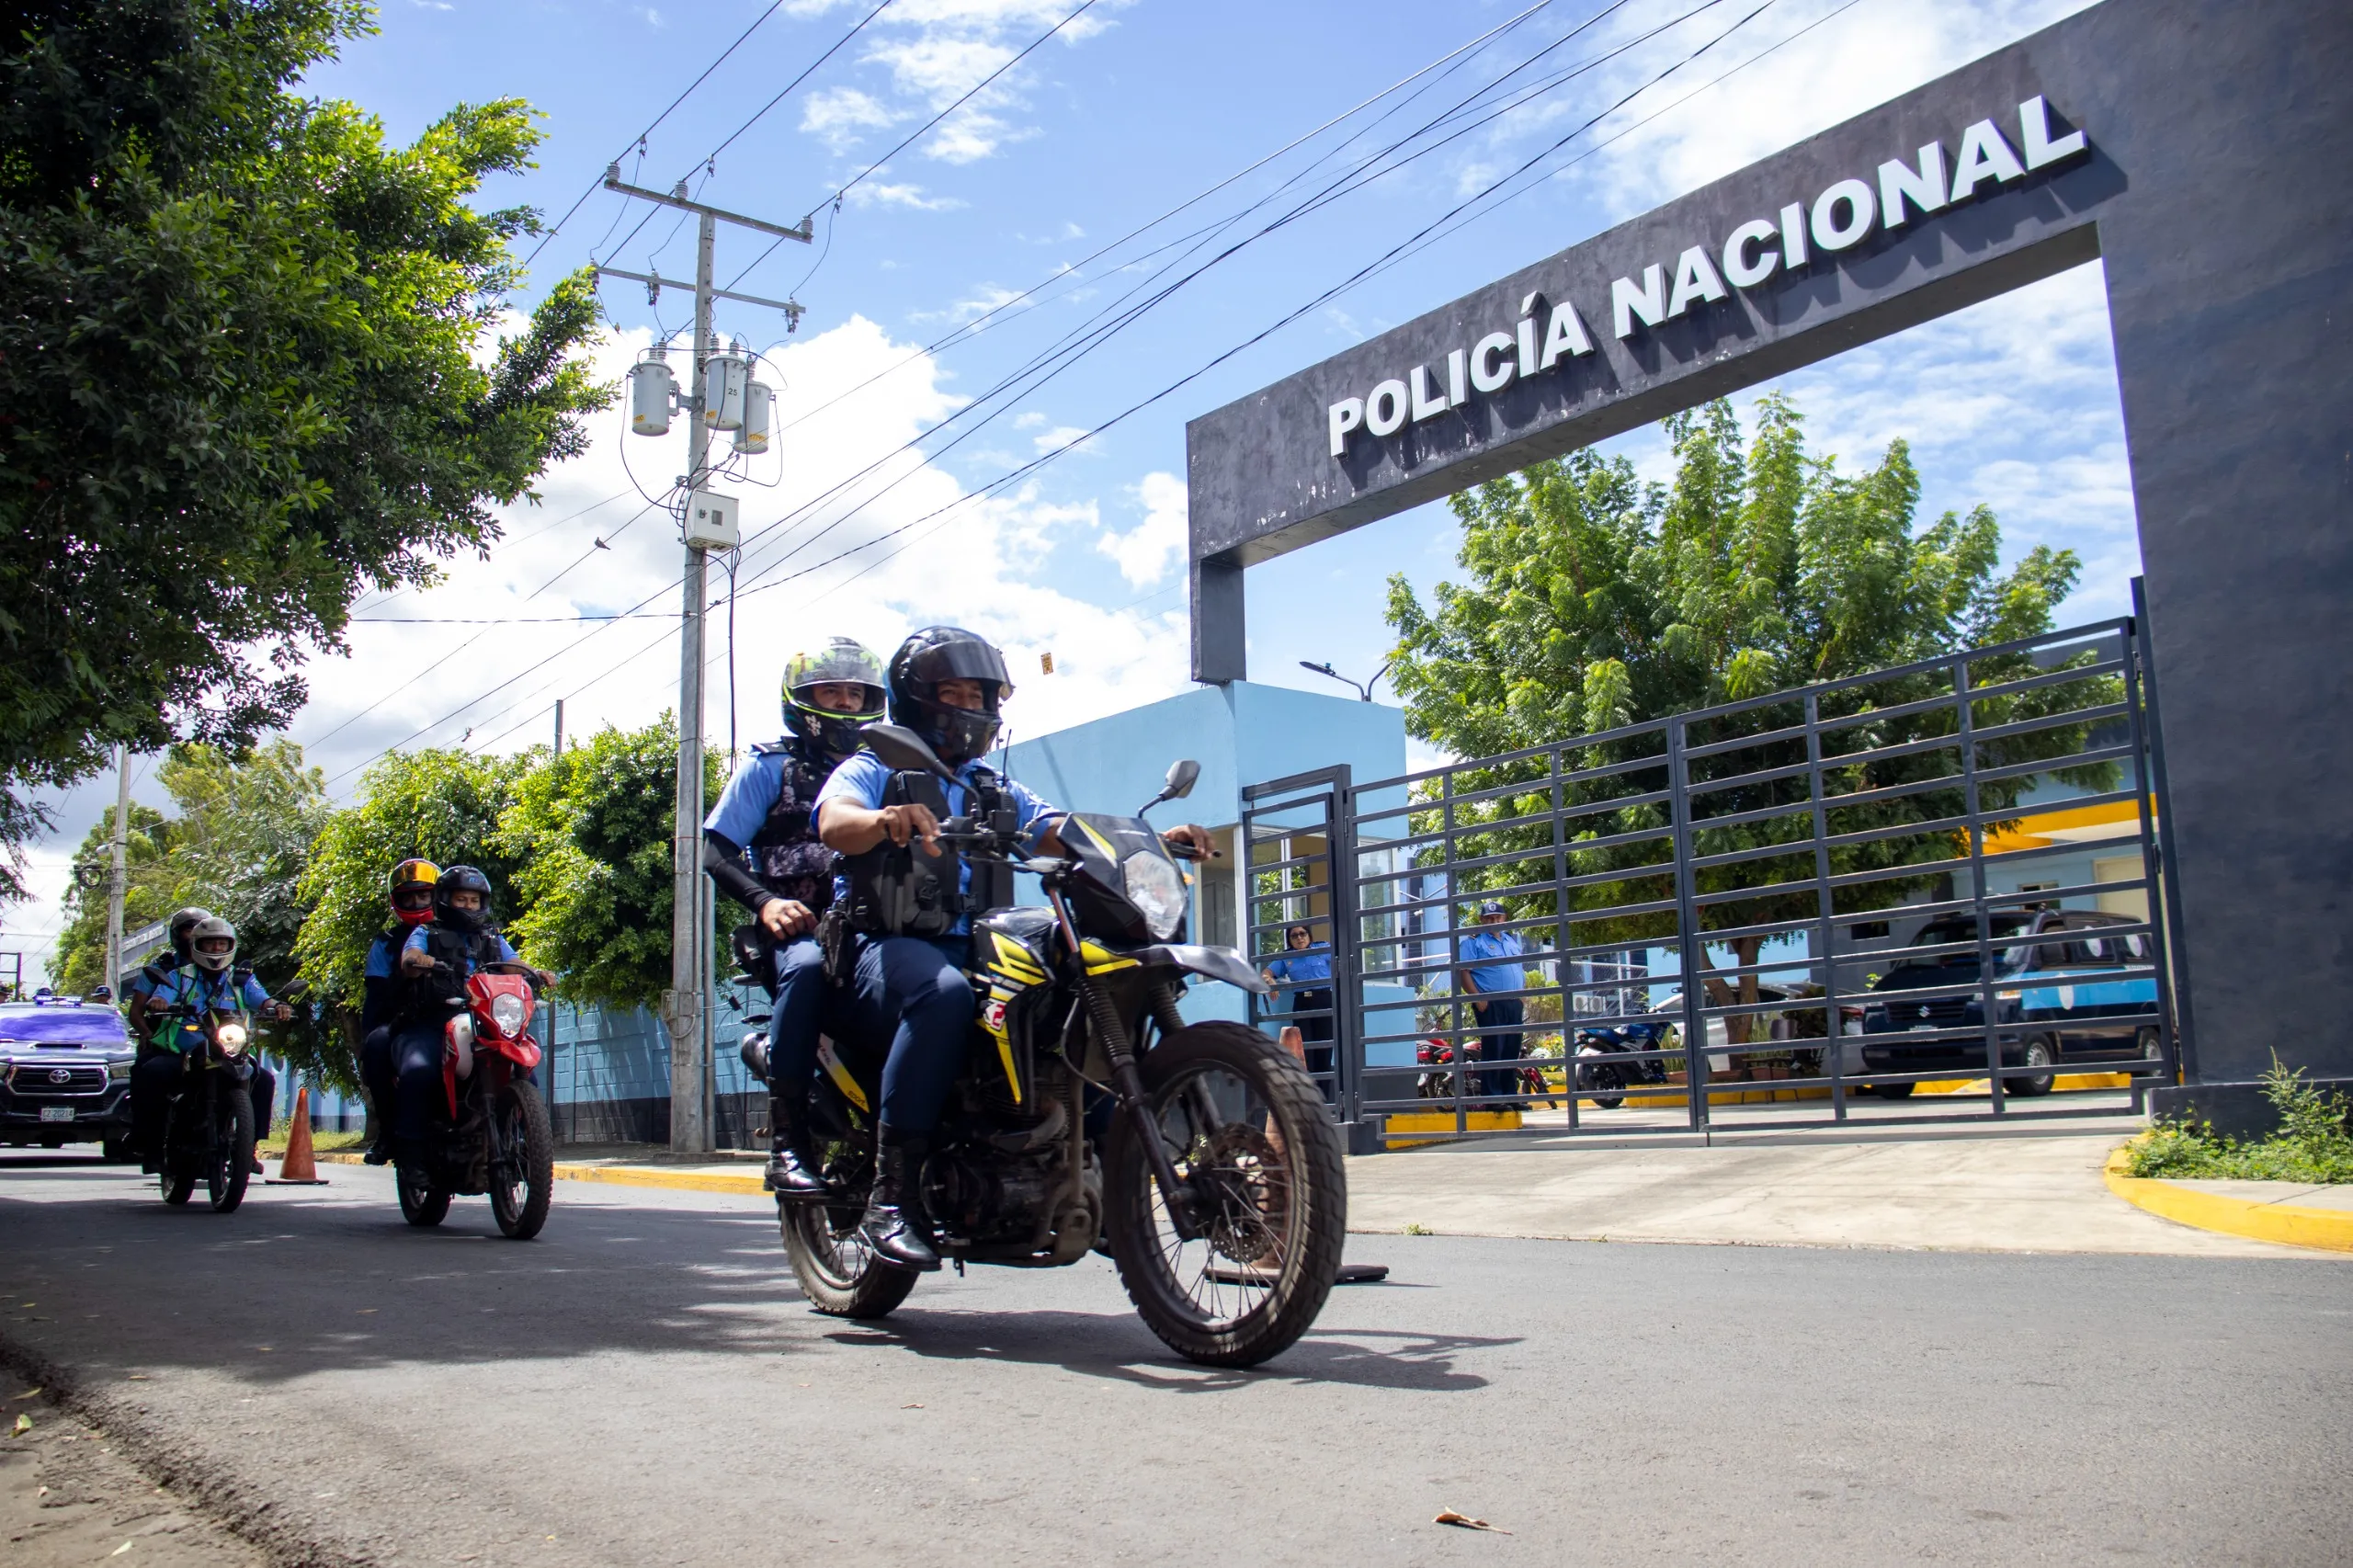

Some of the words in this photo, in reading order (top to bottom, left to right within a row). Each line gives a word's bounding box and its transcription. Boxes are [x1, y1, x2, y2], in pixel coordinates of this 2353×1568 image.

[1328, 290, 1595, 458] POLICÍA
[1611, 95, 2088, 340] NACIONAL
[727, 387, 738, 396] 25
